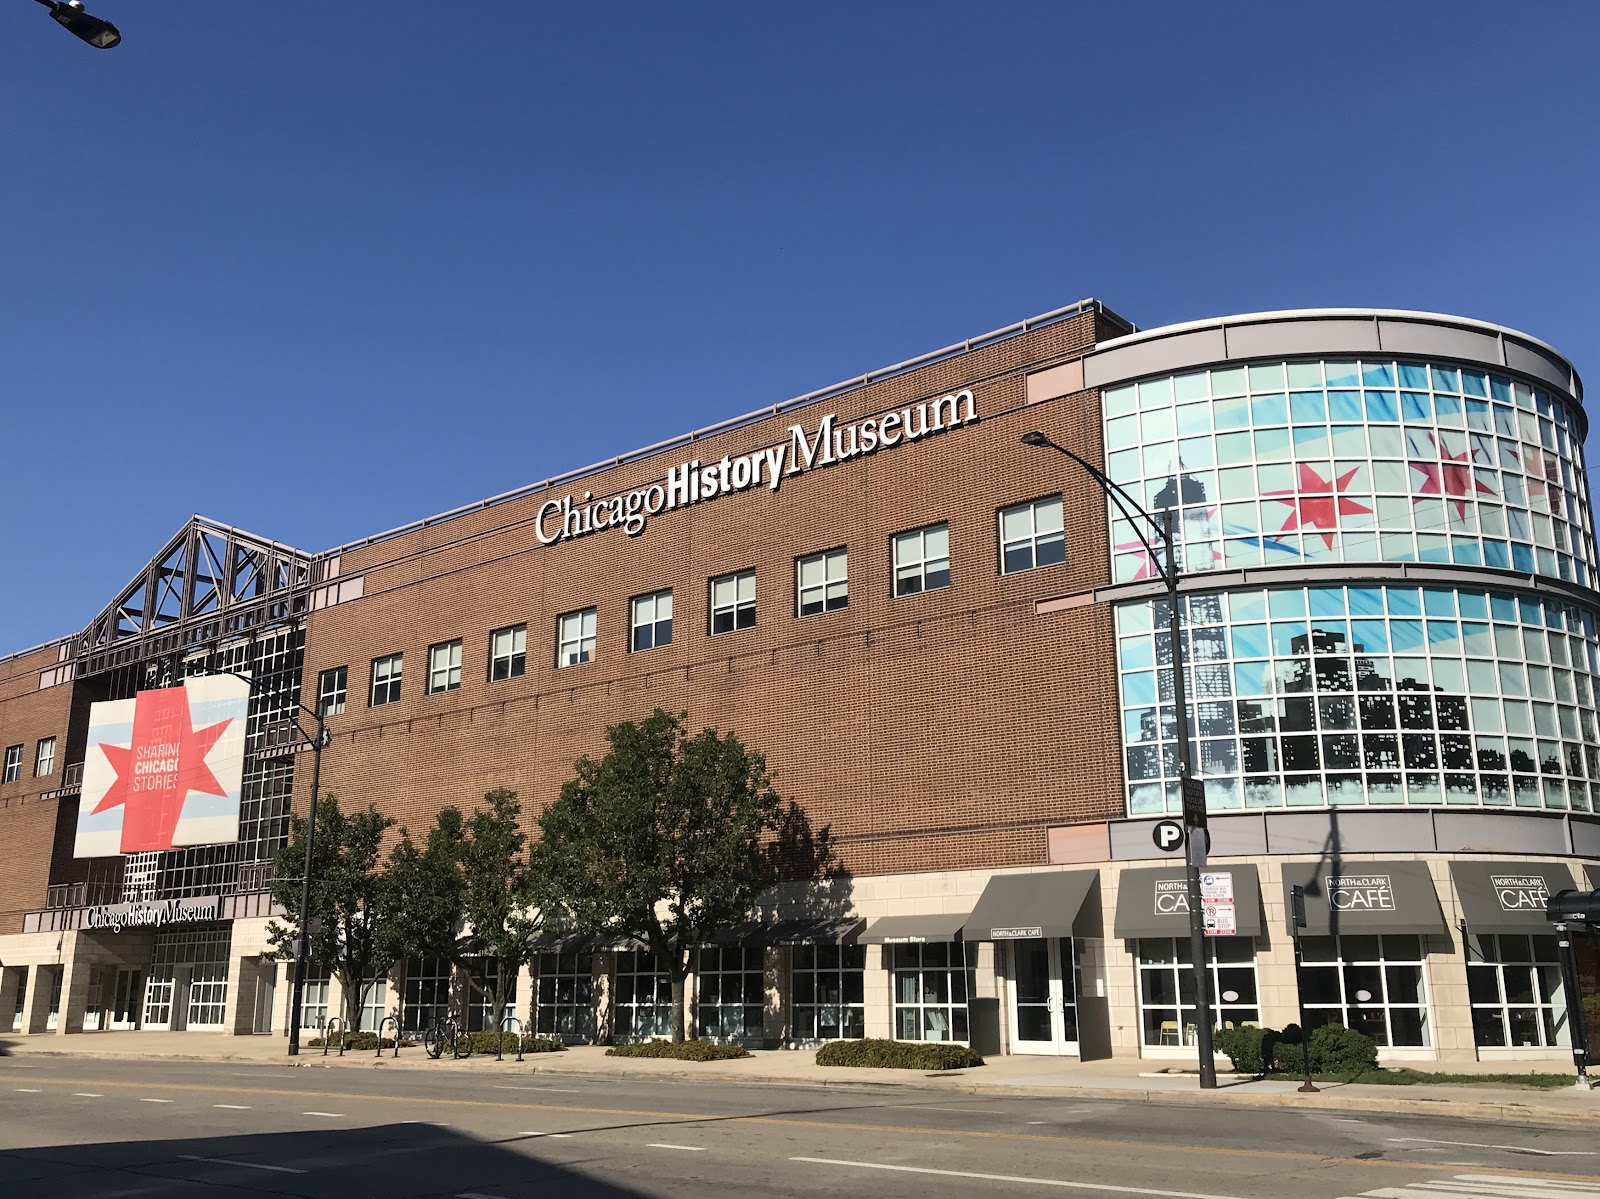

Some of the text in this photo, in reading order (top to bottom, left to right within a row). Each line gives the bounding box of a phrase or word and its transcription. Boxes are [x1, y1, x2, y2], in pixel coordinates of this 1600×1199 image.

[1160, 825, 1180, 847] P
[1158, 882, 1188, 891] NORTH&
[1332, 885, 1392, 909] CAFÉ
[1501, 886, 1548, 908] CAFÉ
[1157, 893, 1190, 912] CA
